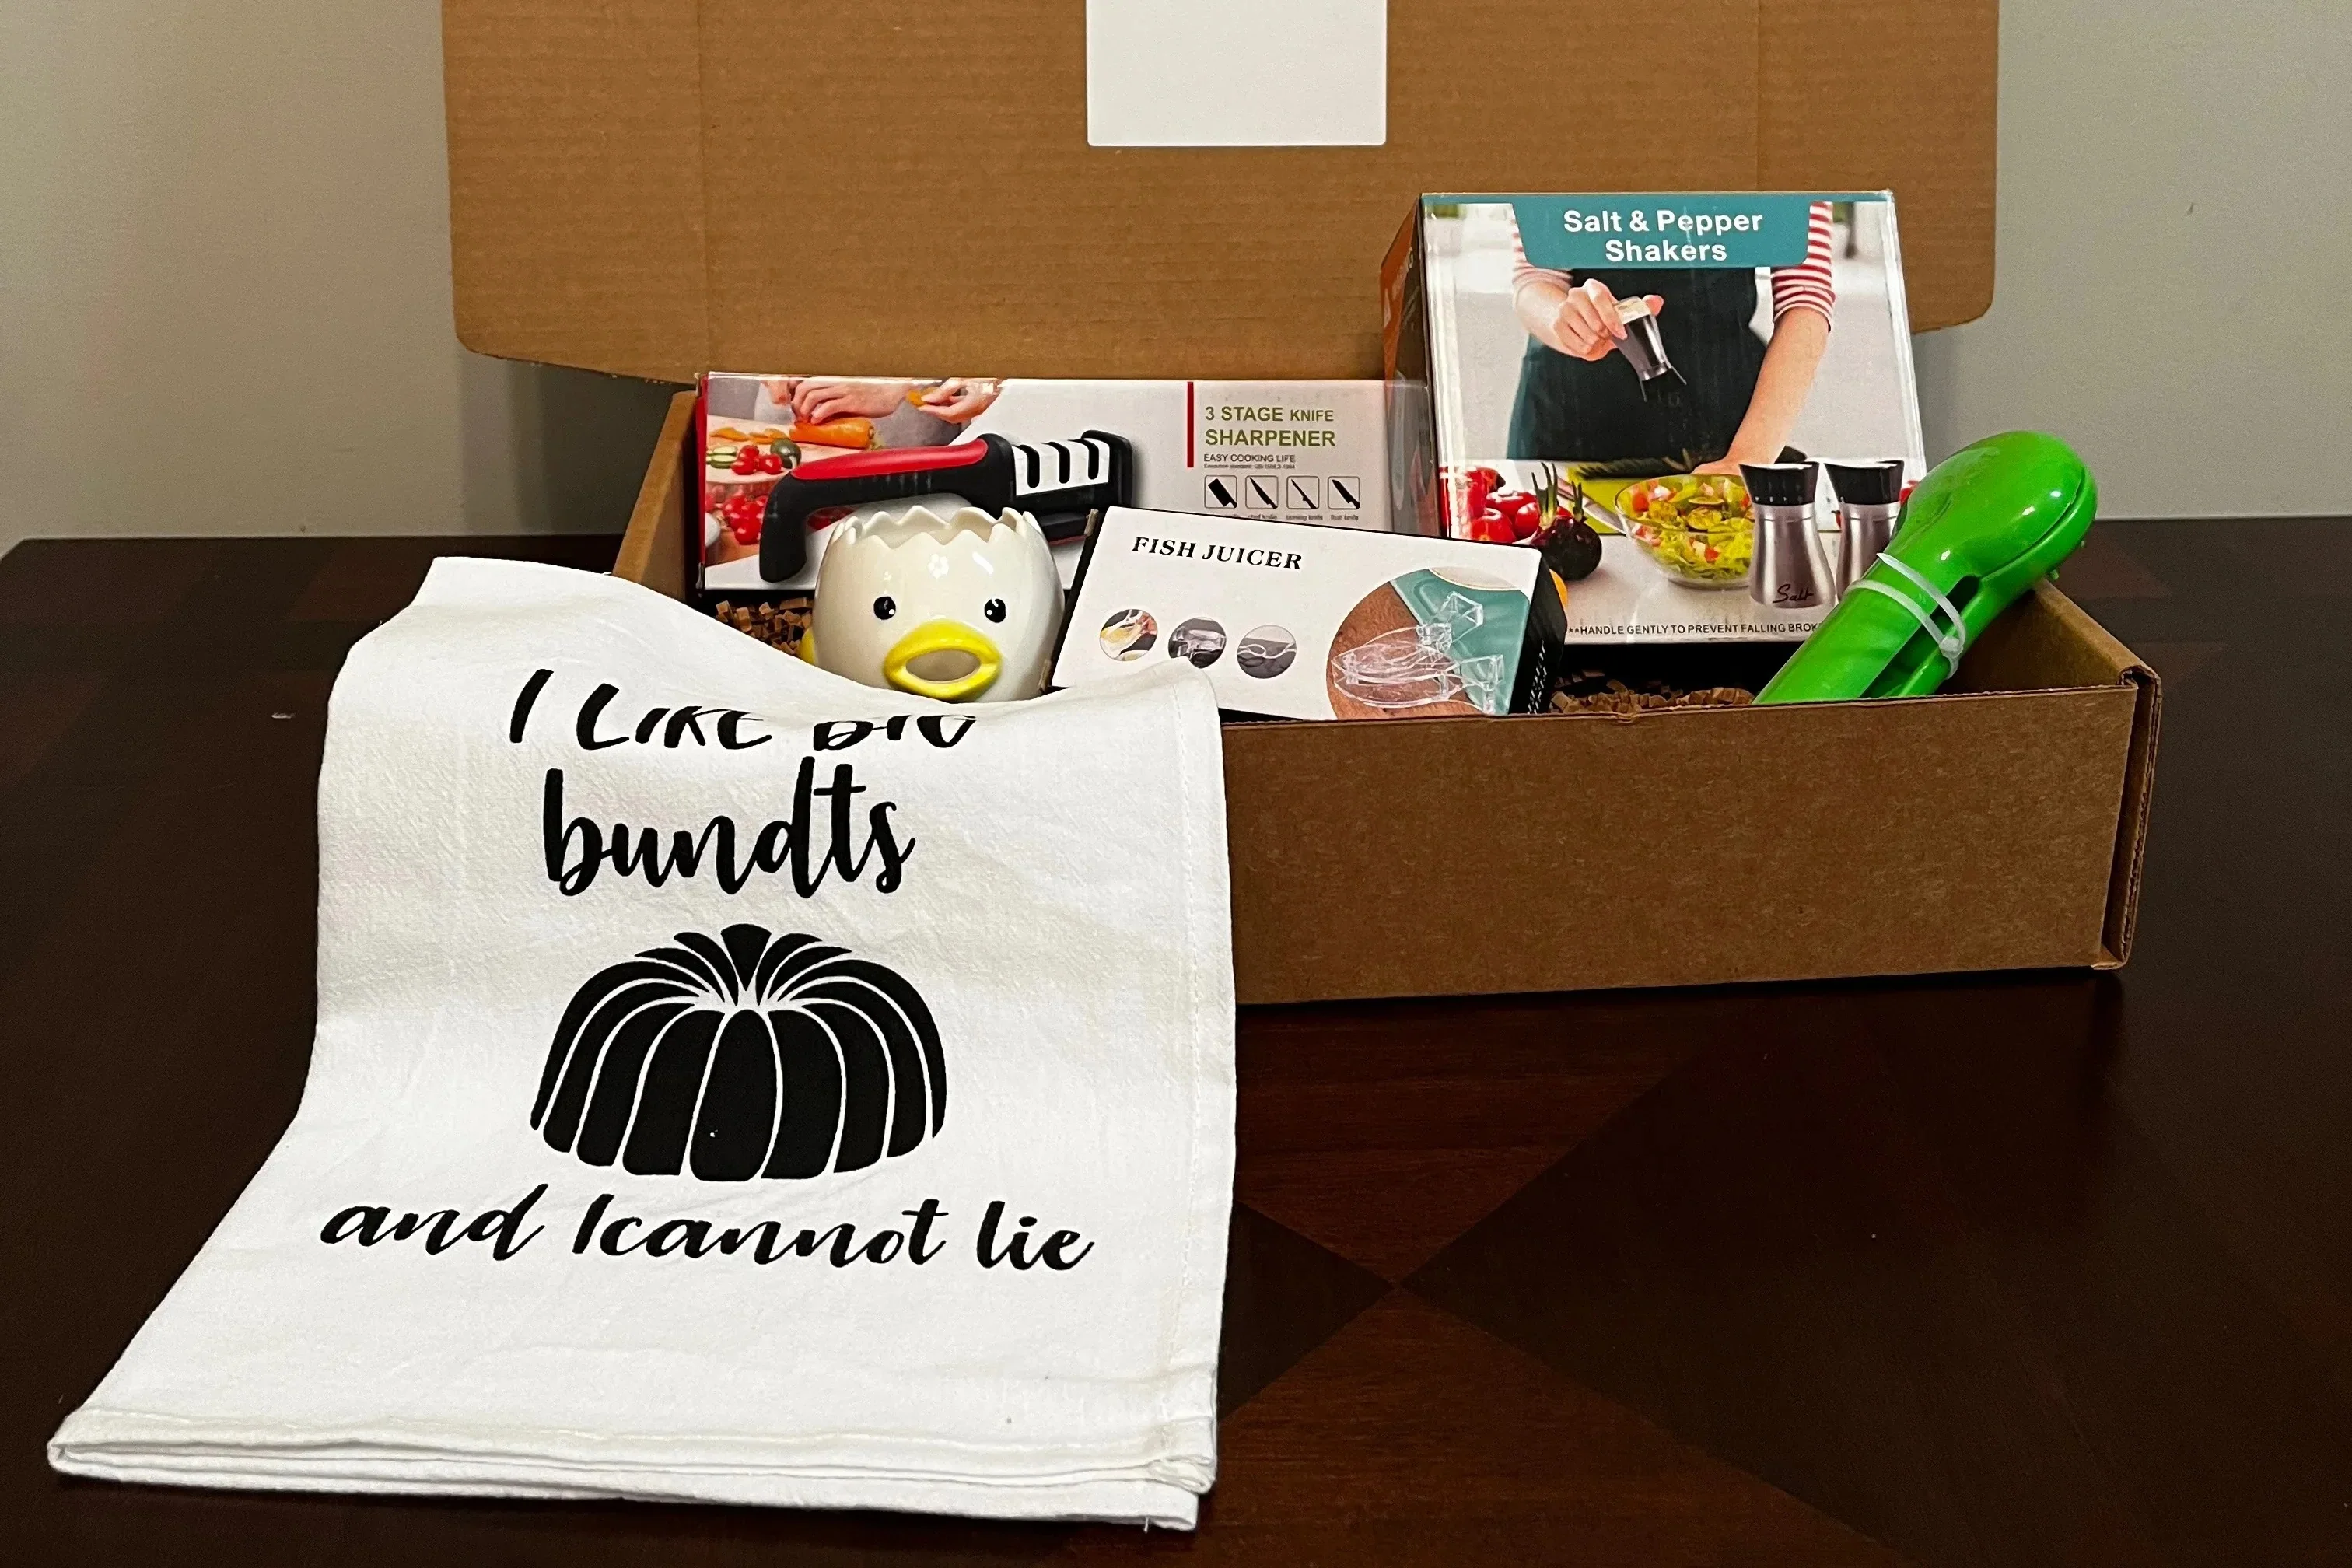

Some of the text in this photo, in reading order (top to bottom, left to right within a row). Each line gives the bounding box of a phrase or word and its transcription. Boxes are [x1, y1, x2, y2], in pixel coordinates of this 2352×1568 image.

[1563, 210, 1763, 236] Salt & Pepper
[1605, 239, 1727, 262] Shakers
[1206, 406, 1334, 422] 3 STAGE KNIFE
[1206, 429, 1335, 447] SHARPENER
[1203, 453, 1296, 464] EASY COOKING LIFE
[1132, 537, 1302, 570] FISH JUICER
[1773, 583, 1814, 604] Salt
[1626, 625, 1668, 635] GENTLY
[1671, 625, 1685, 634] TO
[1688, 624, 1738, 634] PREVENT
[1741, 623, 1787, 633] FALLING
[1788, 623, 1821, 632] BROK
[509, 669, 554, 744] I
[543, 755, 916, 899] bundts
[320, 1183, 549, 1262] and
[976, 1200, 1095, 1271] lie
